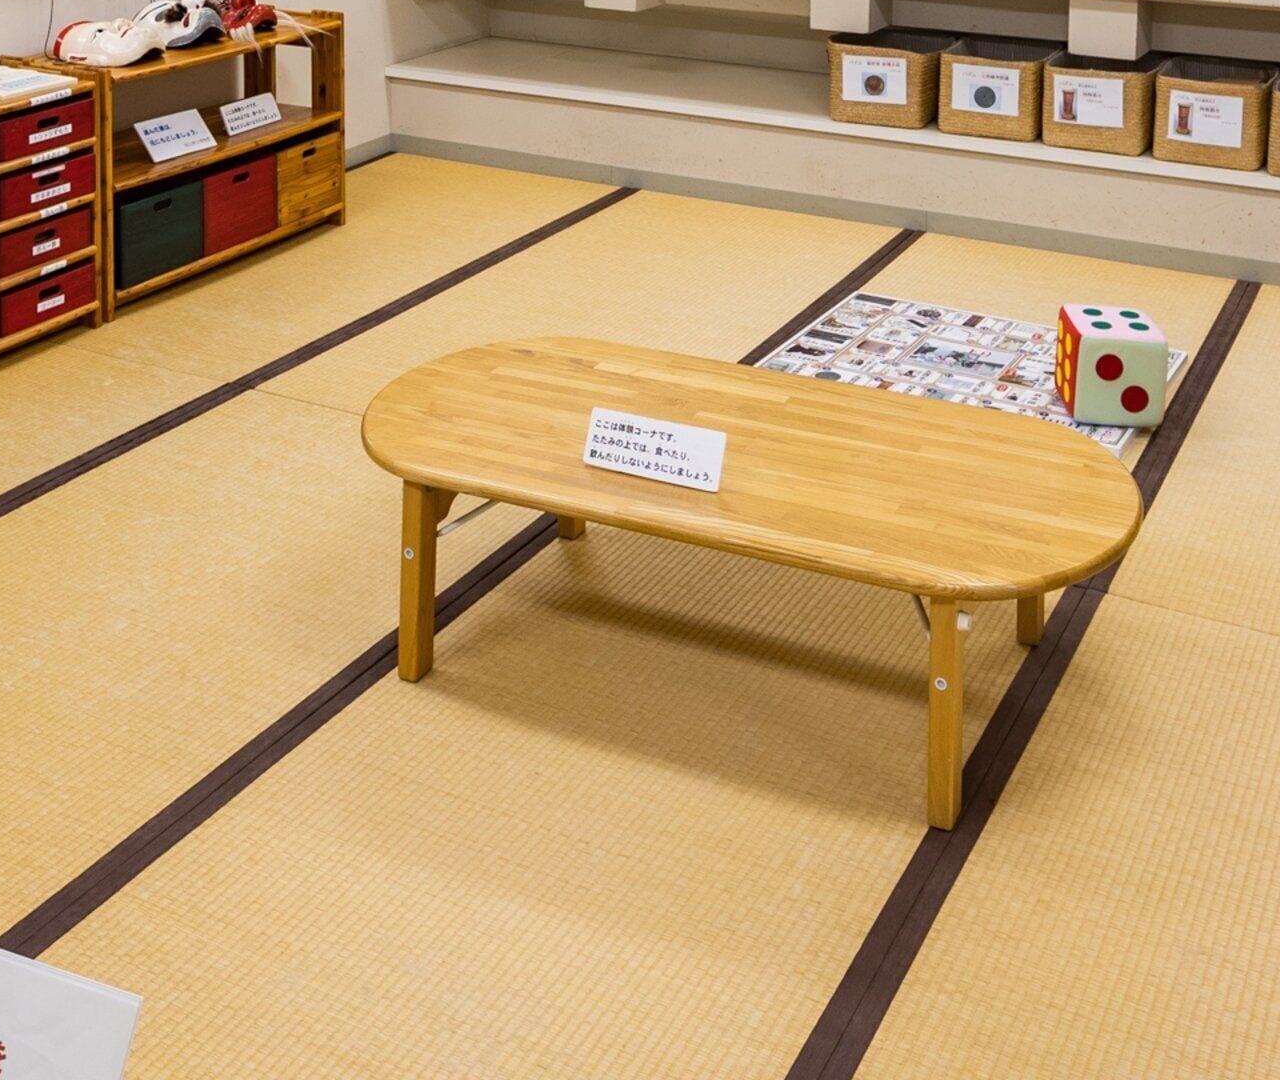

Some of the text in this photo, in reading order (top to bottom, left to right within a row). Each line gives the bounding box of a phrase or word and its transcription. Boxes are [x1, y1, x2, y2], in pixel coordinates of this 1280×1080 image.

[589, 449, 713, 482] 飲んだりしないようにしましょう。
